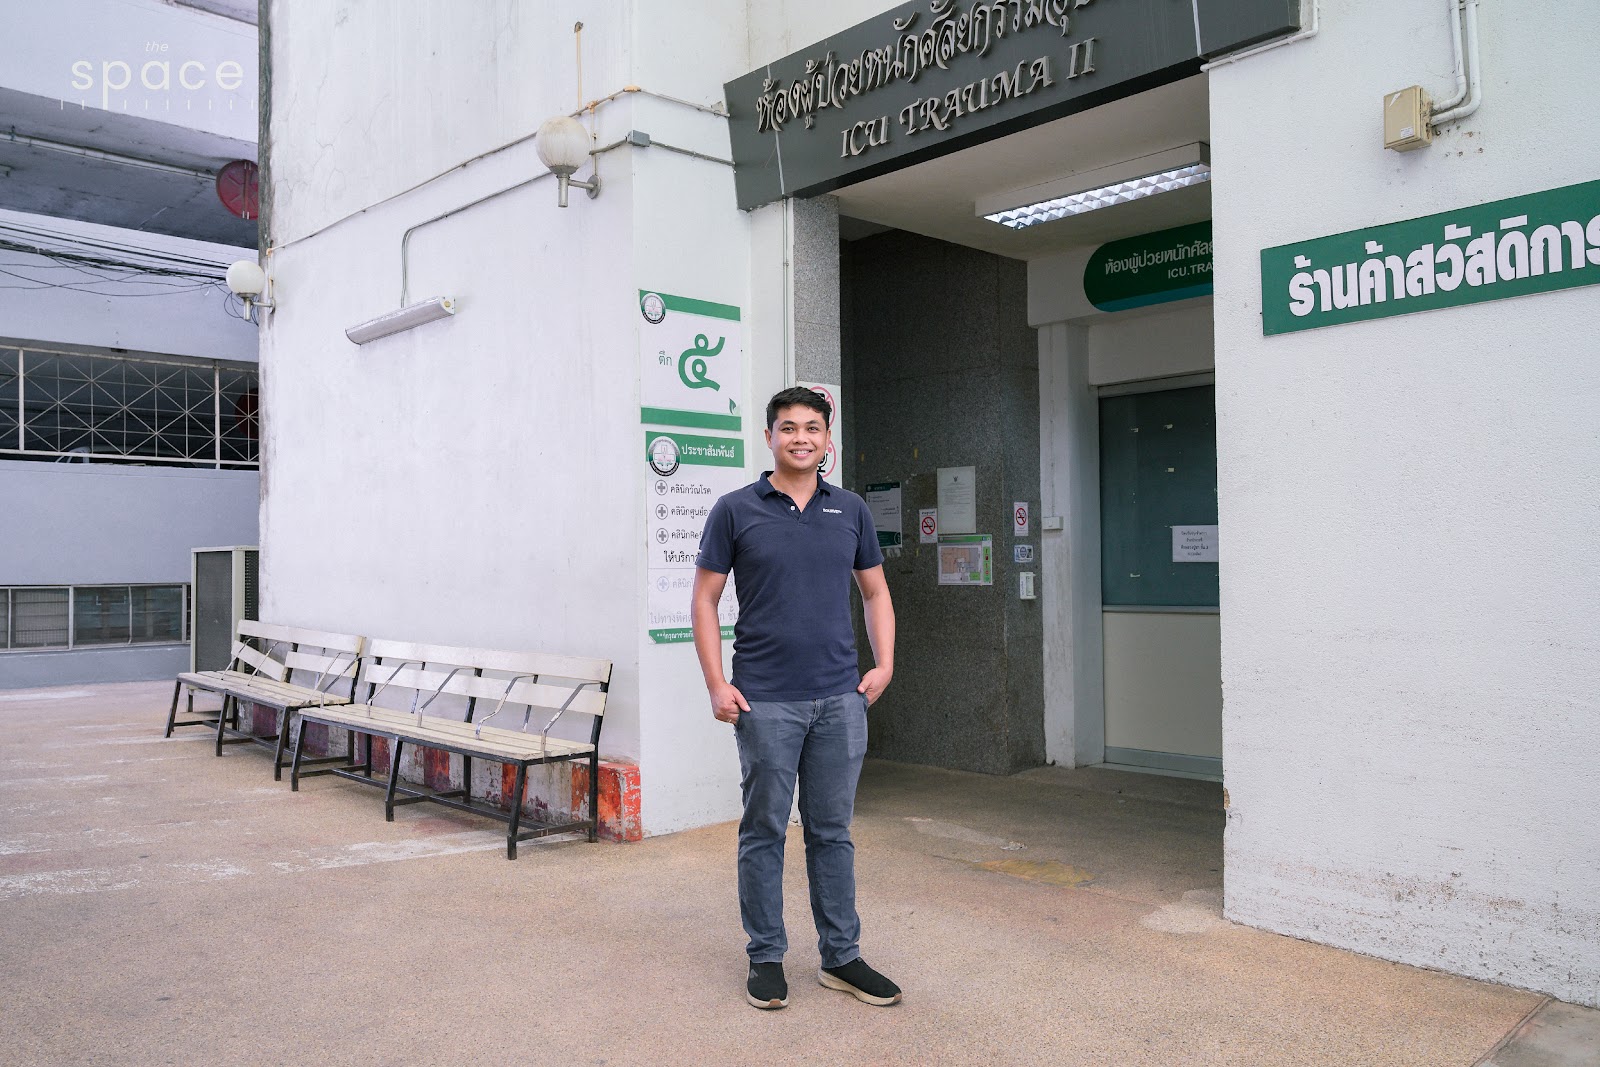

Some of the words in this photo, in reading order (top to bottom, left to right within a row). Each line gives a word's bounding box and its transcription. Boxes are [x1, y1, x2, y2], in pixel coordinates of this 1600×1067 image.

[840, 115, 889, 158] ICU
[899, 55, 1055, 136] TRAUMA
[658, 350, 673, 366] ตึก
[681, 443, 735, 459] ประชาสัมพันธ์
[670, 483, 712, 495] คลินิกวัณโรค
[671, 505, 711, 519] คลินิกศูนย์อ
